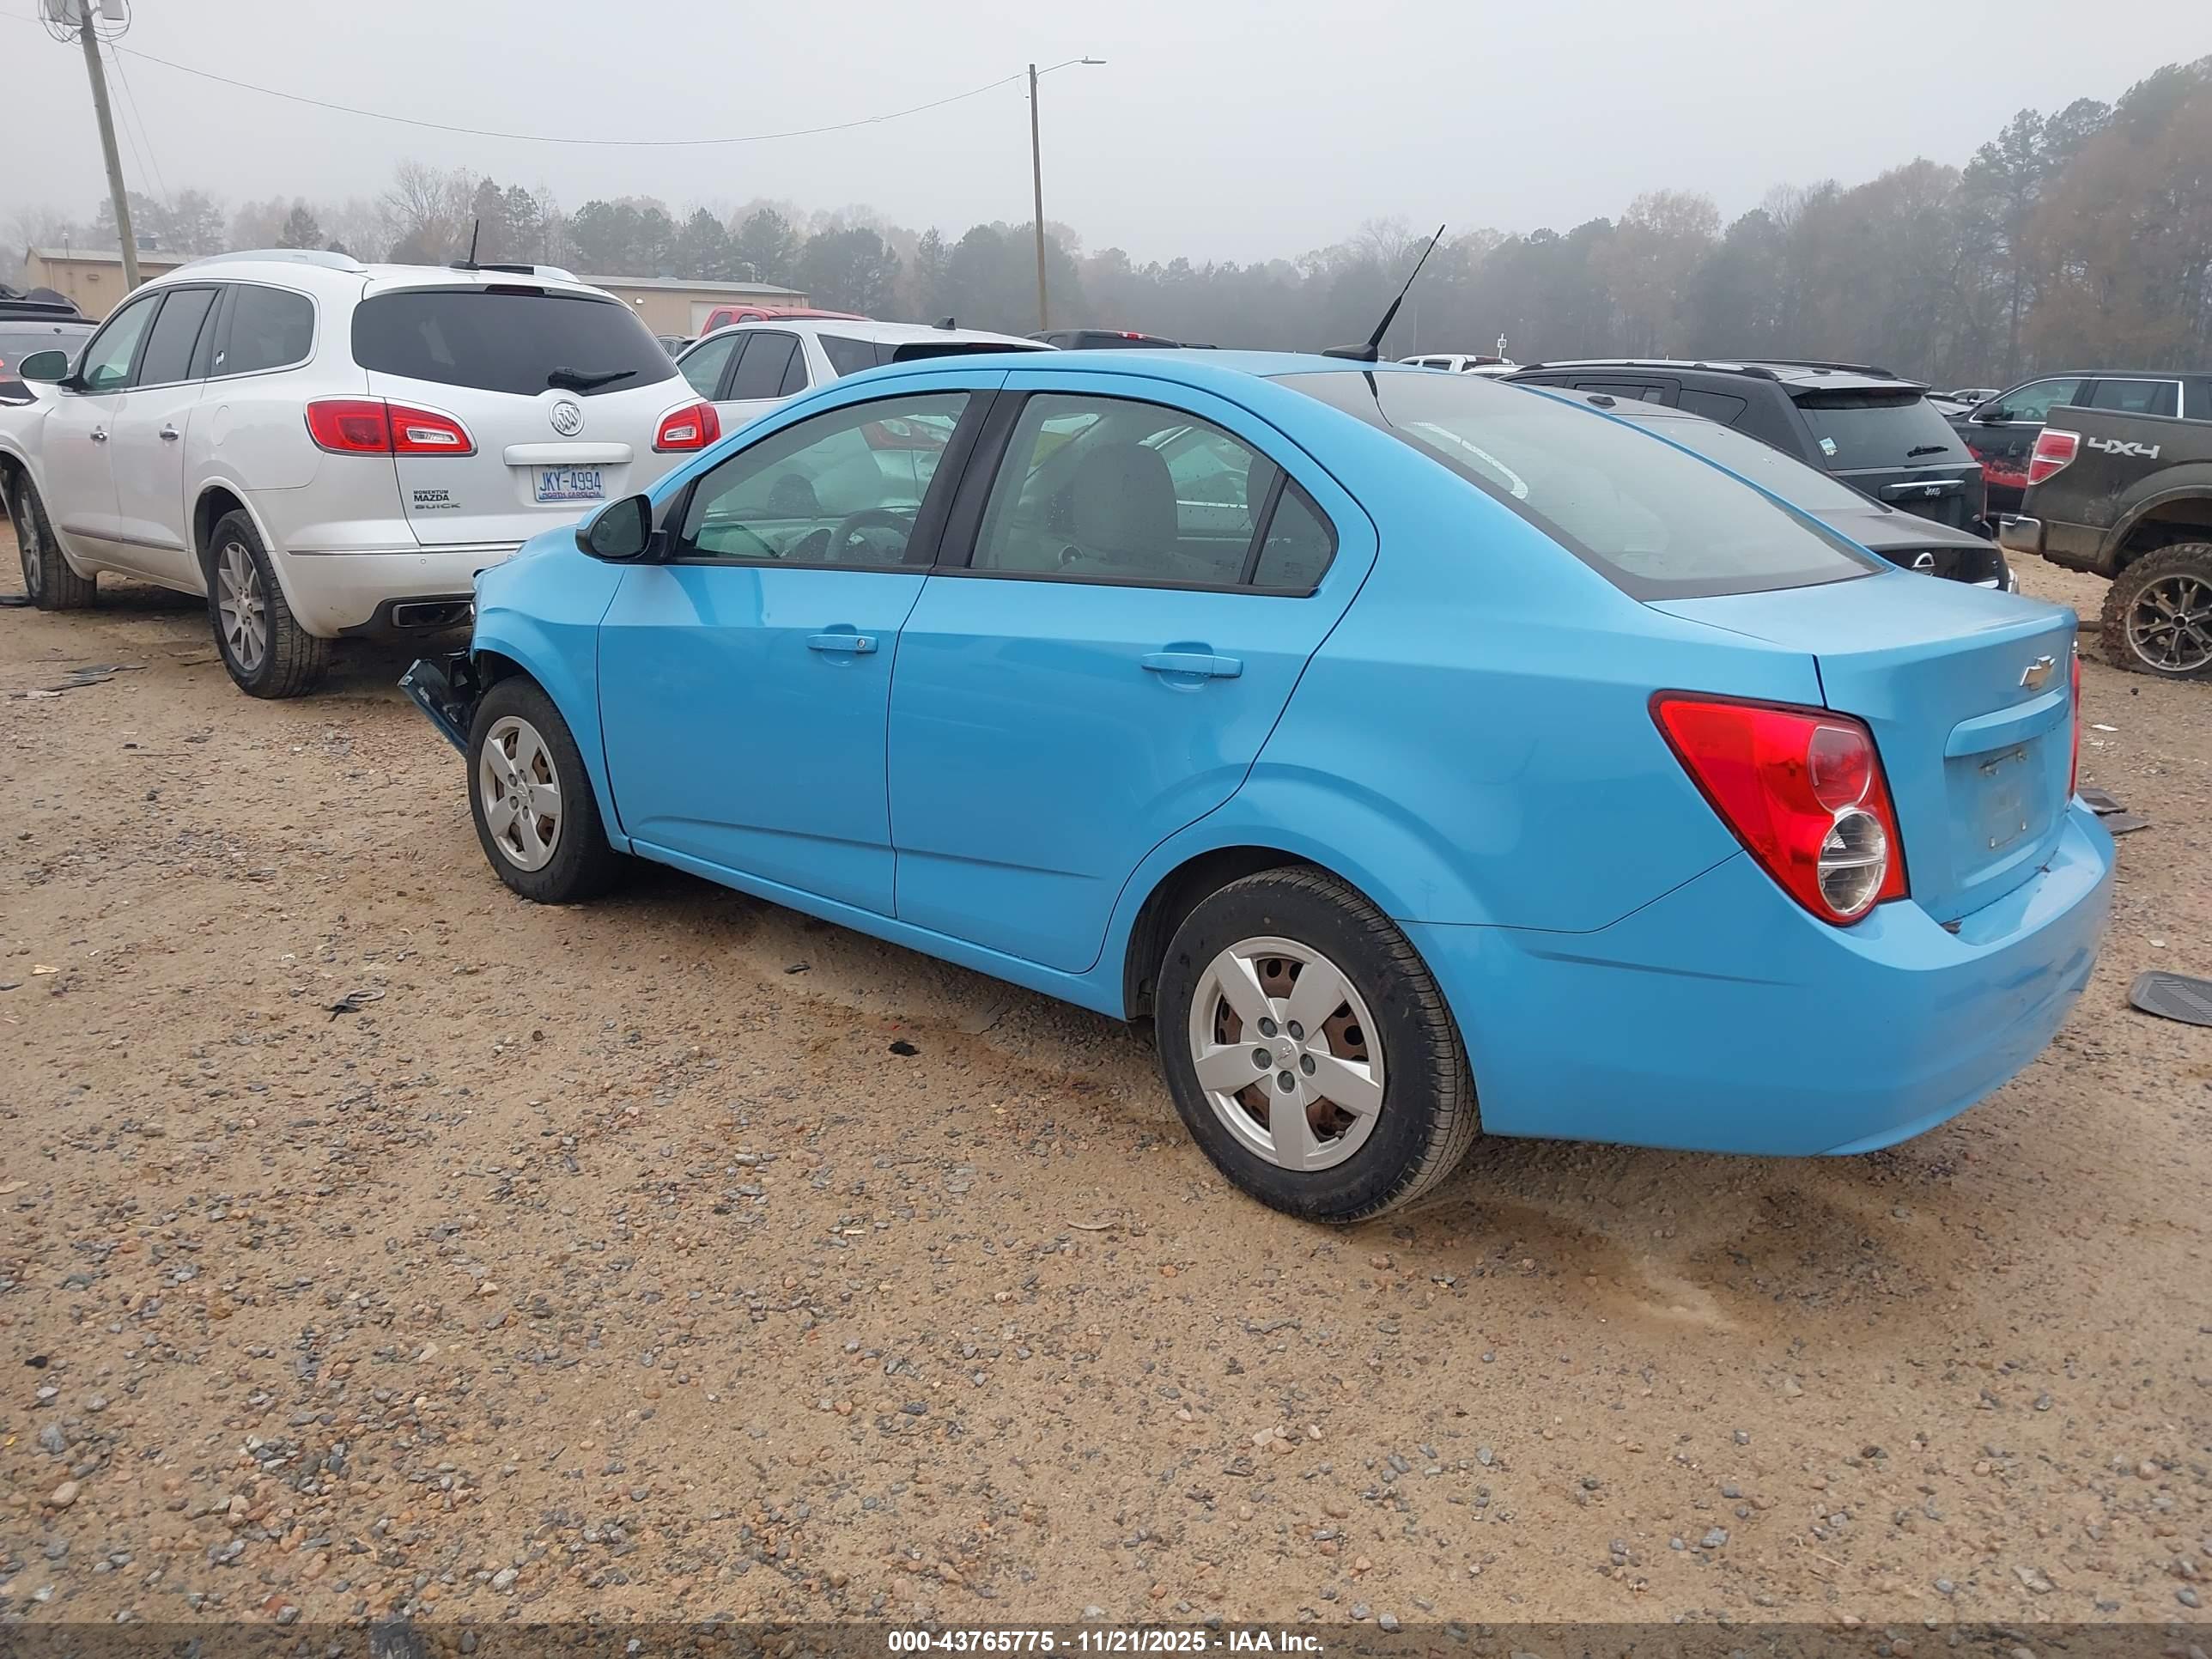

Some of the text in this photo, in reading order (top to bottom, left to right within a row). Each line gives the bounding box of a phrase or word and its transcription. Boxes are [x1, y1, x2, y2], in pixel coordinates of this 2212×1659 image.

[2087, 437, 2161, 459] 4X4
[539, 471, 602, 491] JKY-4994
[1923, 486, 1942, 497] Jeep
